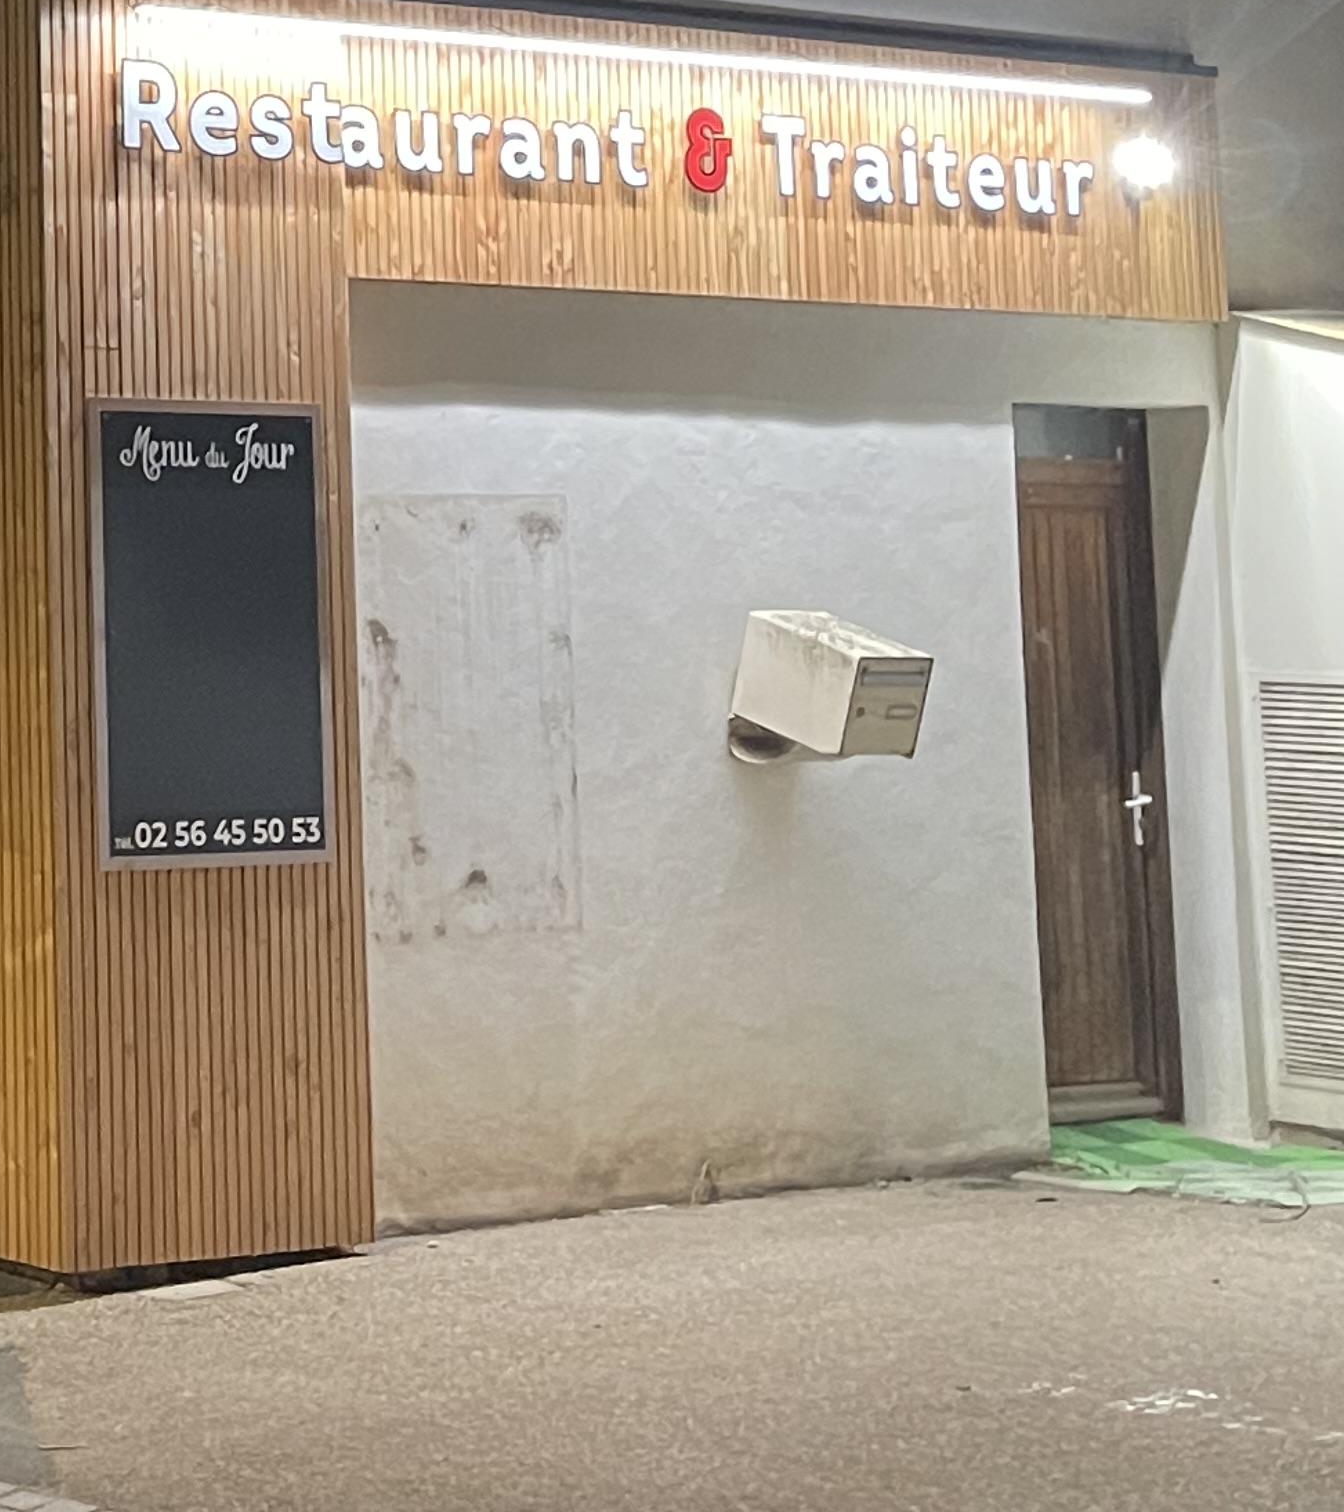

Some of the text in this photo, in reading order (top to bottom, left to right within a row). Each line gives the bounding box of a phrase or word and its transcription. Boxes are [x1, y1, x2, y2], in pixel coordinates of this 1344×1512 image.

[121, 57, 1095, 217] Restaurant & Traiteur
[119, 422, 295, 484] Menu du Jour
[134, 821, 168, 849] 02
[174, 820, 207, 847] 56
[213, 818, 246, 846] 45
[252, 817, 285, 844] 50
[292, 816, 321, 844] 53
